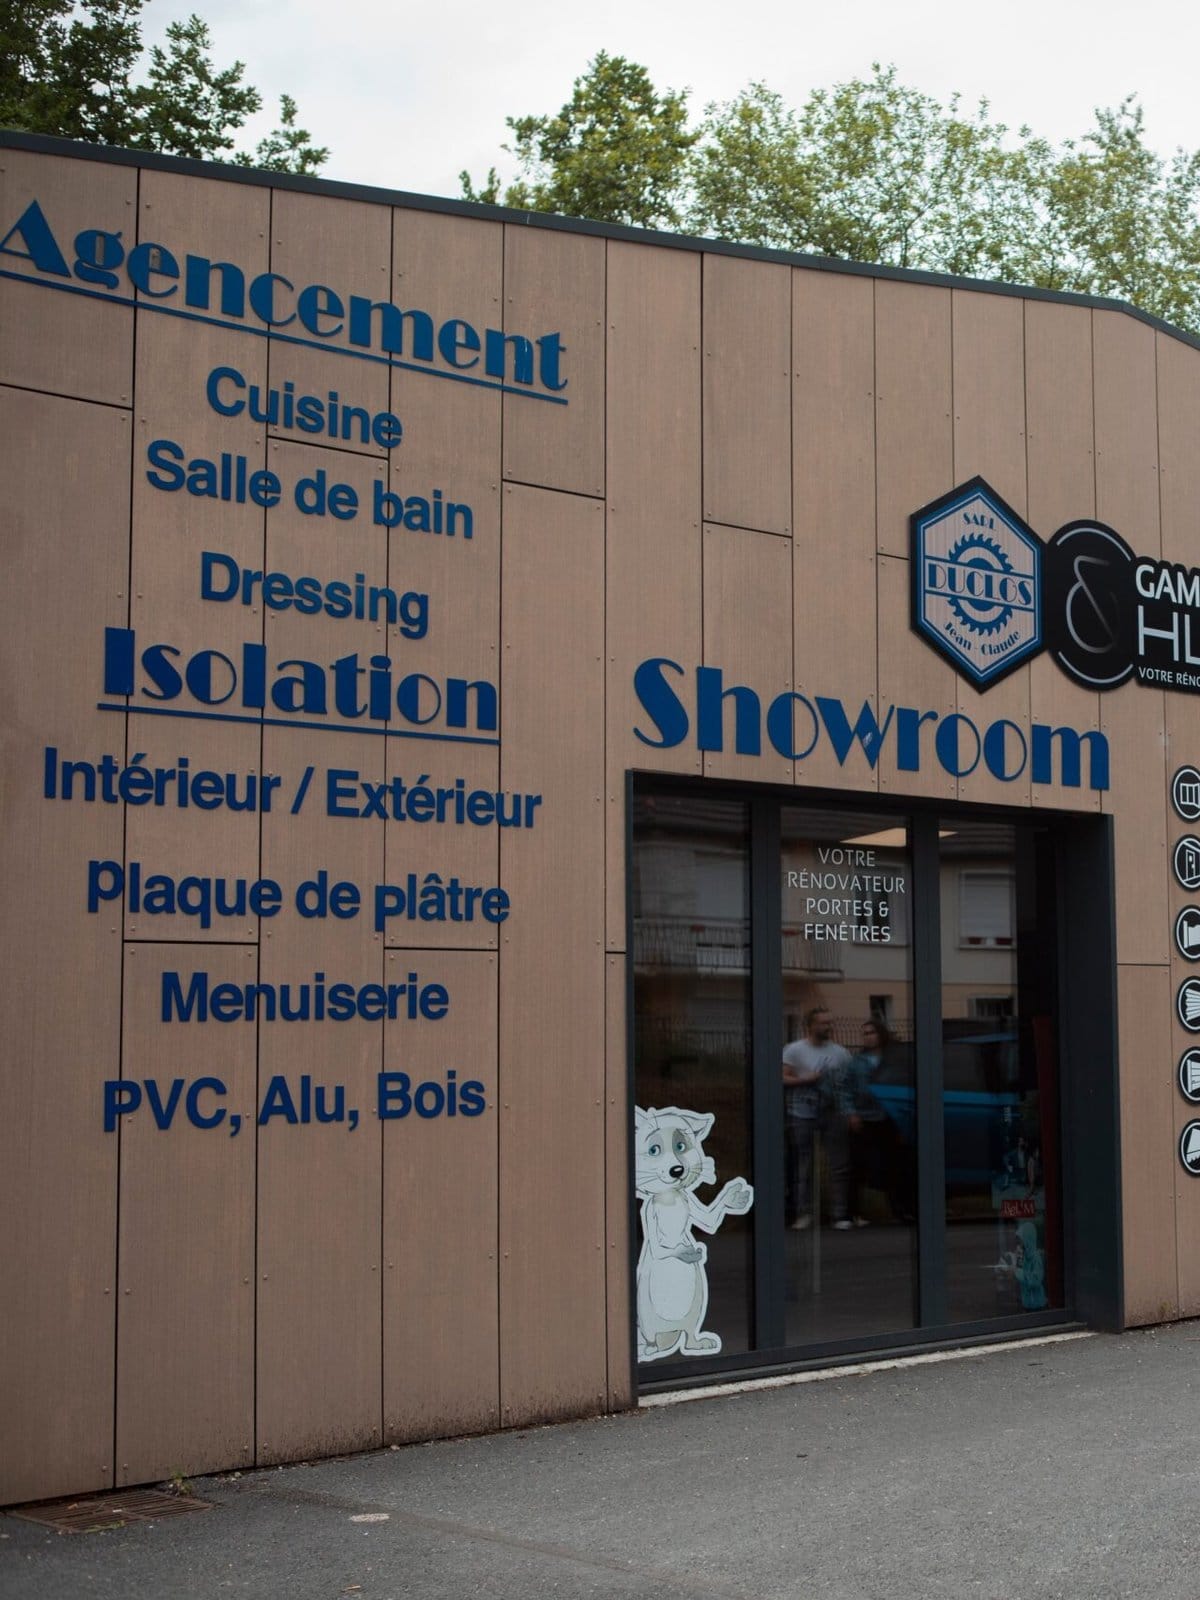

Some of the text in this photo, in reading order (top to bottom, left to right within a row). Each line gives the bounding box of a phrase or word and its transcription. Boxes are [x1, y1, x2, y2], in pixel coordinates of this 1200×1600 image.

[0, 200, 568, 392] Agencement
[206, 366, 404, 449] Cuisine
[146, 440, 475, 540] Salle de bain
[200, 551, 430, 641] Dressing
[928, 562, 1034, 606] DUCLOS
[944, 621, 973, 652] Jean
[980, 630, 1021, 657] Claude
[104, 626, 498, 731] Isolation
[1138, 666, 1173, 683] VOTRE
[633, 657, 1110, 792] Showroom
[43, 747, 281, 813] Intérieur
[326, 768, 543, 829] Extérieur
[787, 867, 906, 894] RÉNOVATEUR
[818, 848, 875, 867] VOTRE
[87, 860, 510, 932] plaque de plâtre
[806, 897, 889, 918] PORTES &
[804, 920, 892, 942] FENÊTRES
[161, 972, 450, 1023] Menuiserie
[103, 1070, 487, 1138] PVC, Alu, Bois
